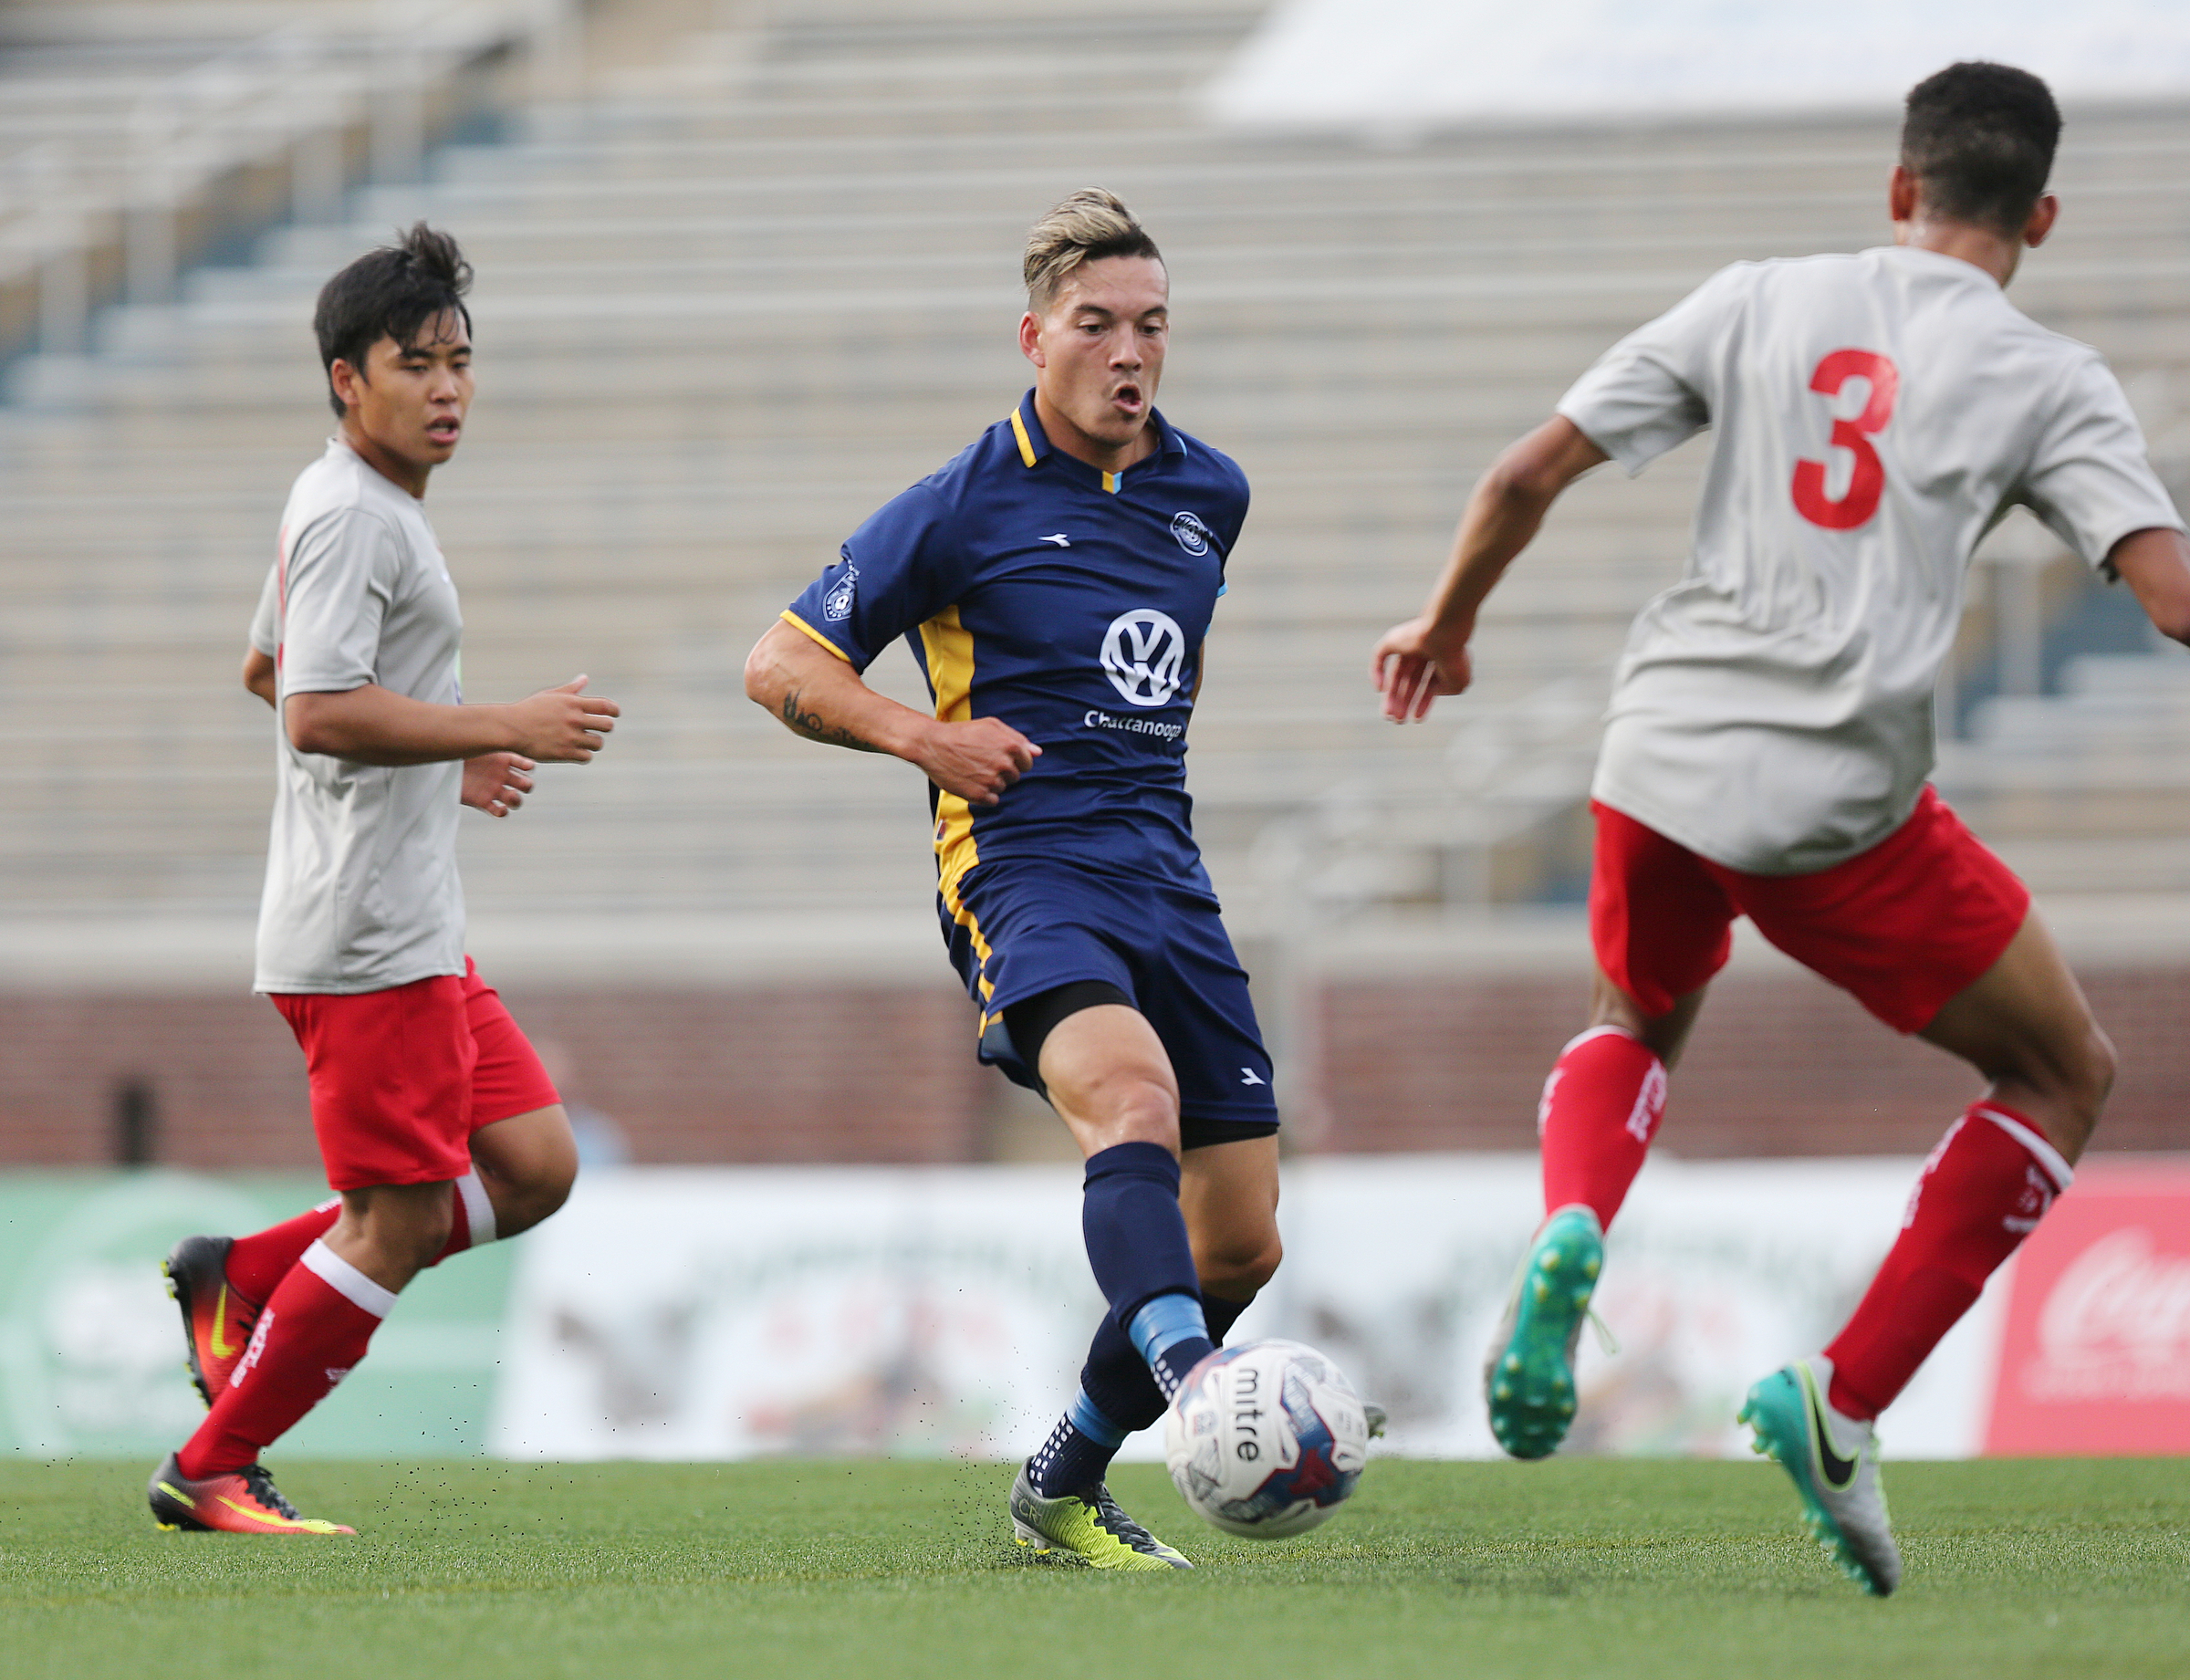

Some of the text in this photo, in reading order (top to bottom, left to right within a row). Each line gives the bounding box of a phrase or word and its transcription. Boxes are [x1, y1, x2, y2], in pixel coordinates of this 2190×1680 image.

[1790, 348, 1898, 530] 3
[1084, 710, 1182, 742] Chattanooga
[1236, 1369, 1263, 1461] mitre
